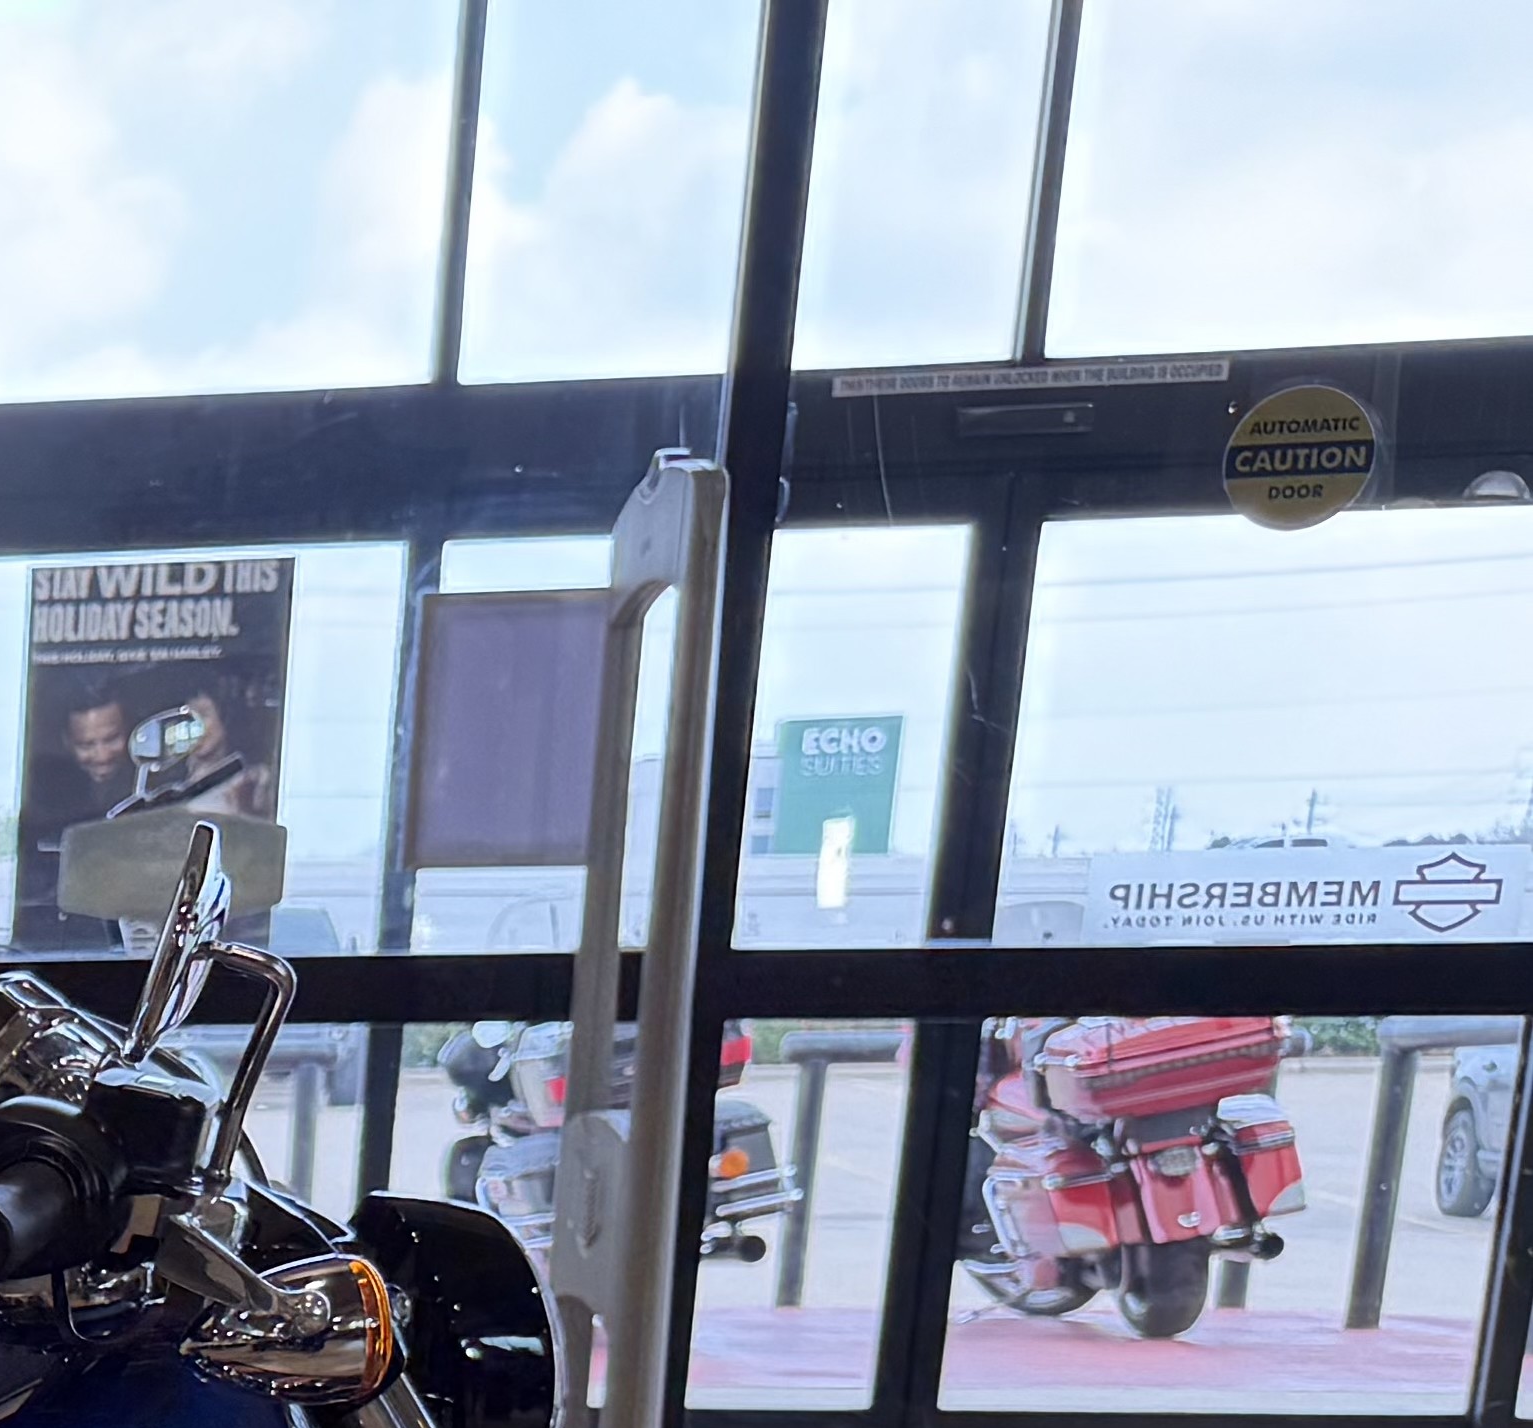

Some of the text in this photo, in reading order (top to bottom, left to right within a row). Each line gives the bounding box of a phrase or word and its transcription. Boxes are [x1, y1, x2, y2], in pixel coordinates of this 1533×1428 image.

[1250, 417, 1360, 436] AUTOMATIC
[1235, 446, 1367, 473] CAUTION
[1268, 484, 1324, 500] DOOR
[35, 560, 280, 600] STAY WILD THIS
[33, 601, 133, 642] HOLIDAY
[802, 727, 886, 755] ECHO
[801, 753, 883, 777] SUITES
